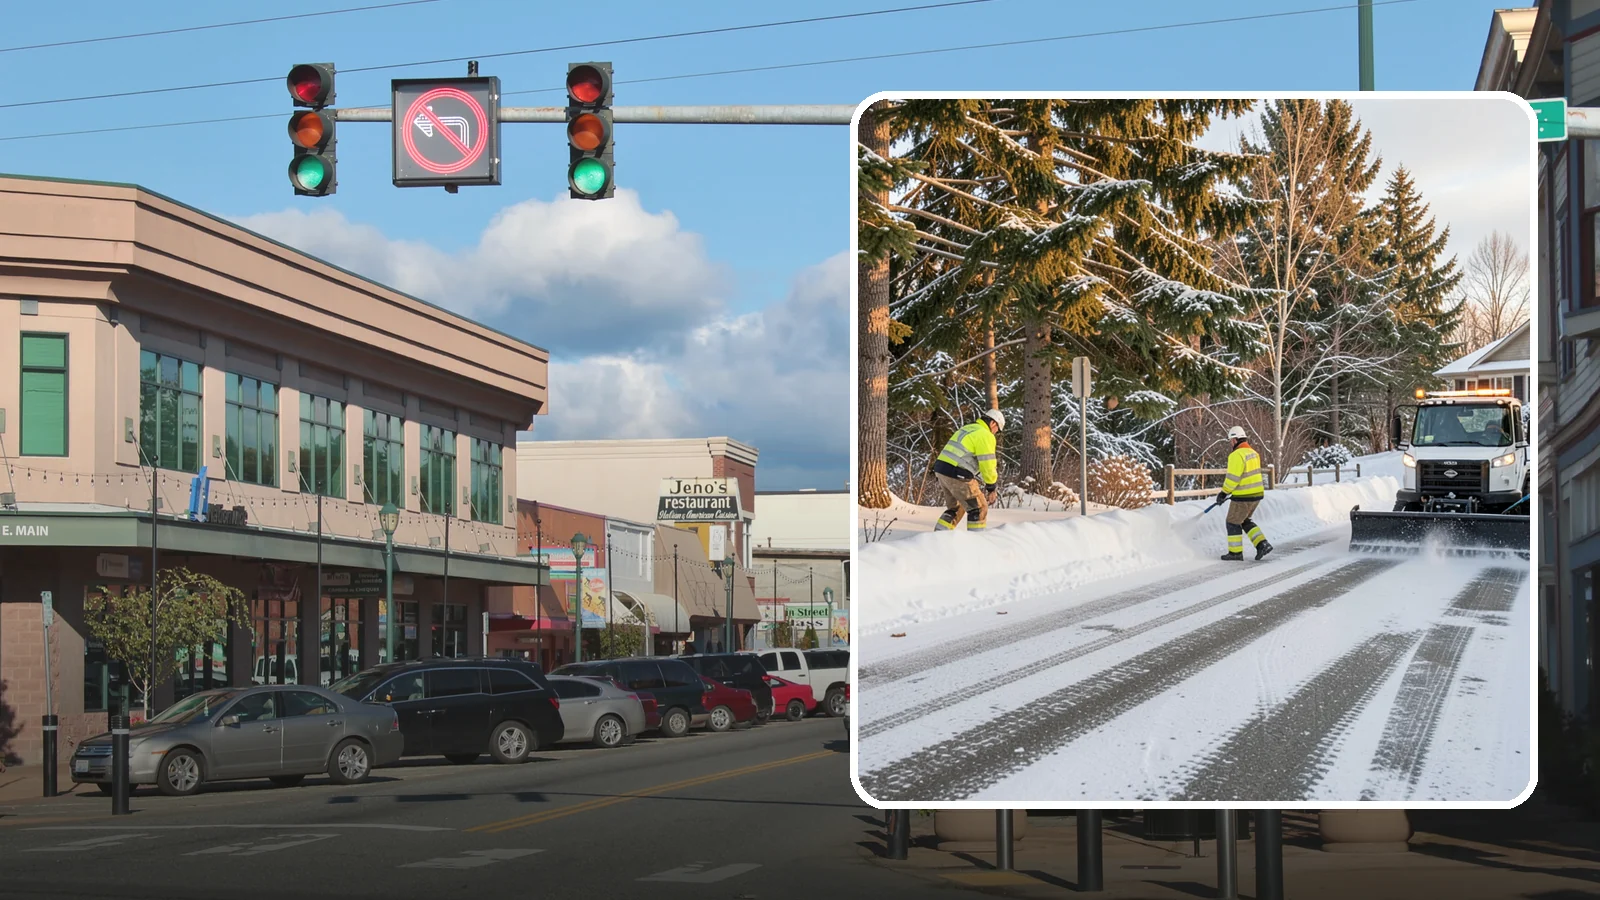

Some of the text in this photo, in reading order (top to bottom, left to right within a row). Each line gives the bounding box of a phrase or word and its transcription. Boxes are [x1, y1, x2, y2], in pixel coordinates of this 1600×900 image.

[670, 480, 727, 494] Jeno's
[665, 497, 730, 509] restaurant
[659, 510, 681, 519] Italian
[686, 510, 714, 519] American
[715, 510, 737, 519] Cuisine
[2, 525, 49, 536] E. MAIN
[797, 607, 828, 616] Street
[791, 619, 823, 627] lass
